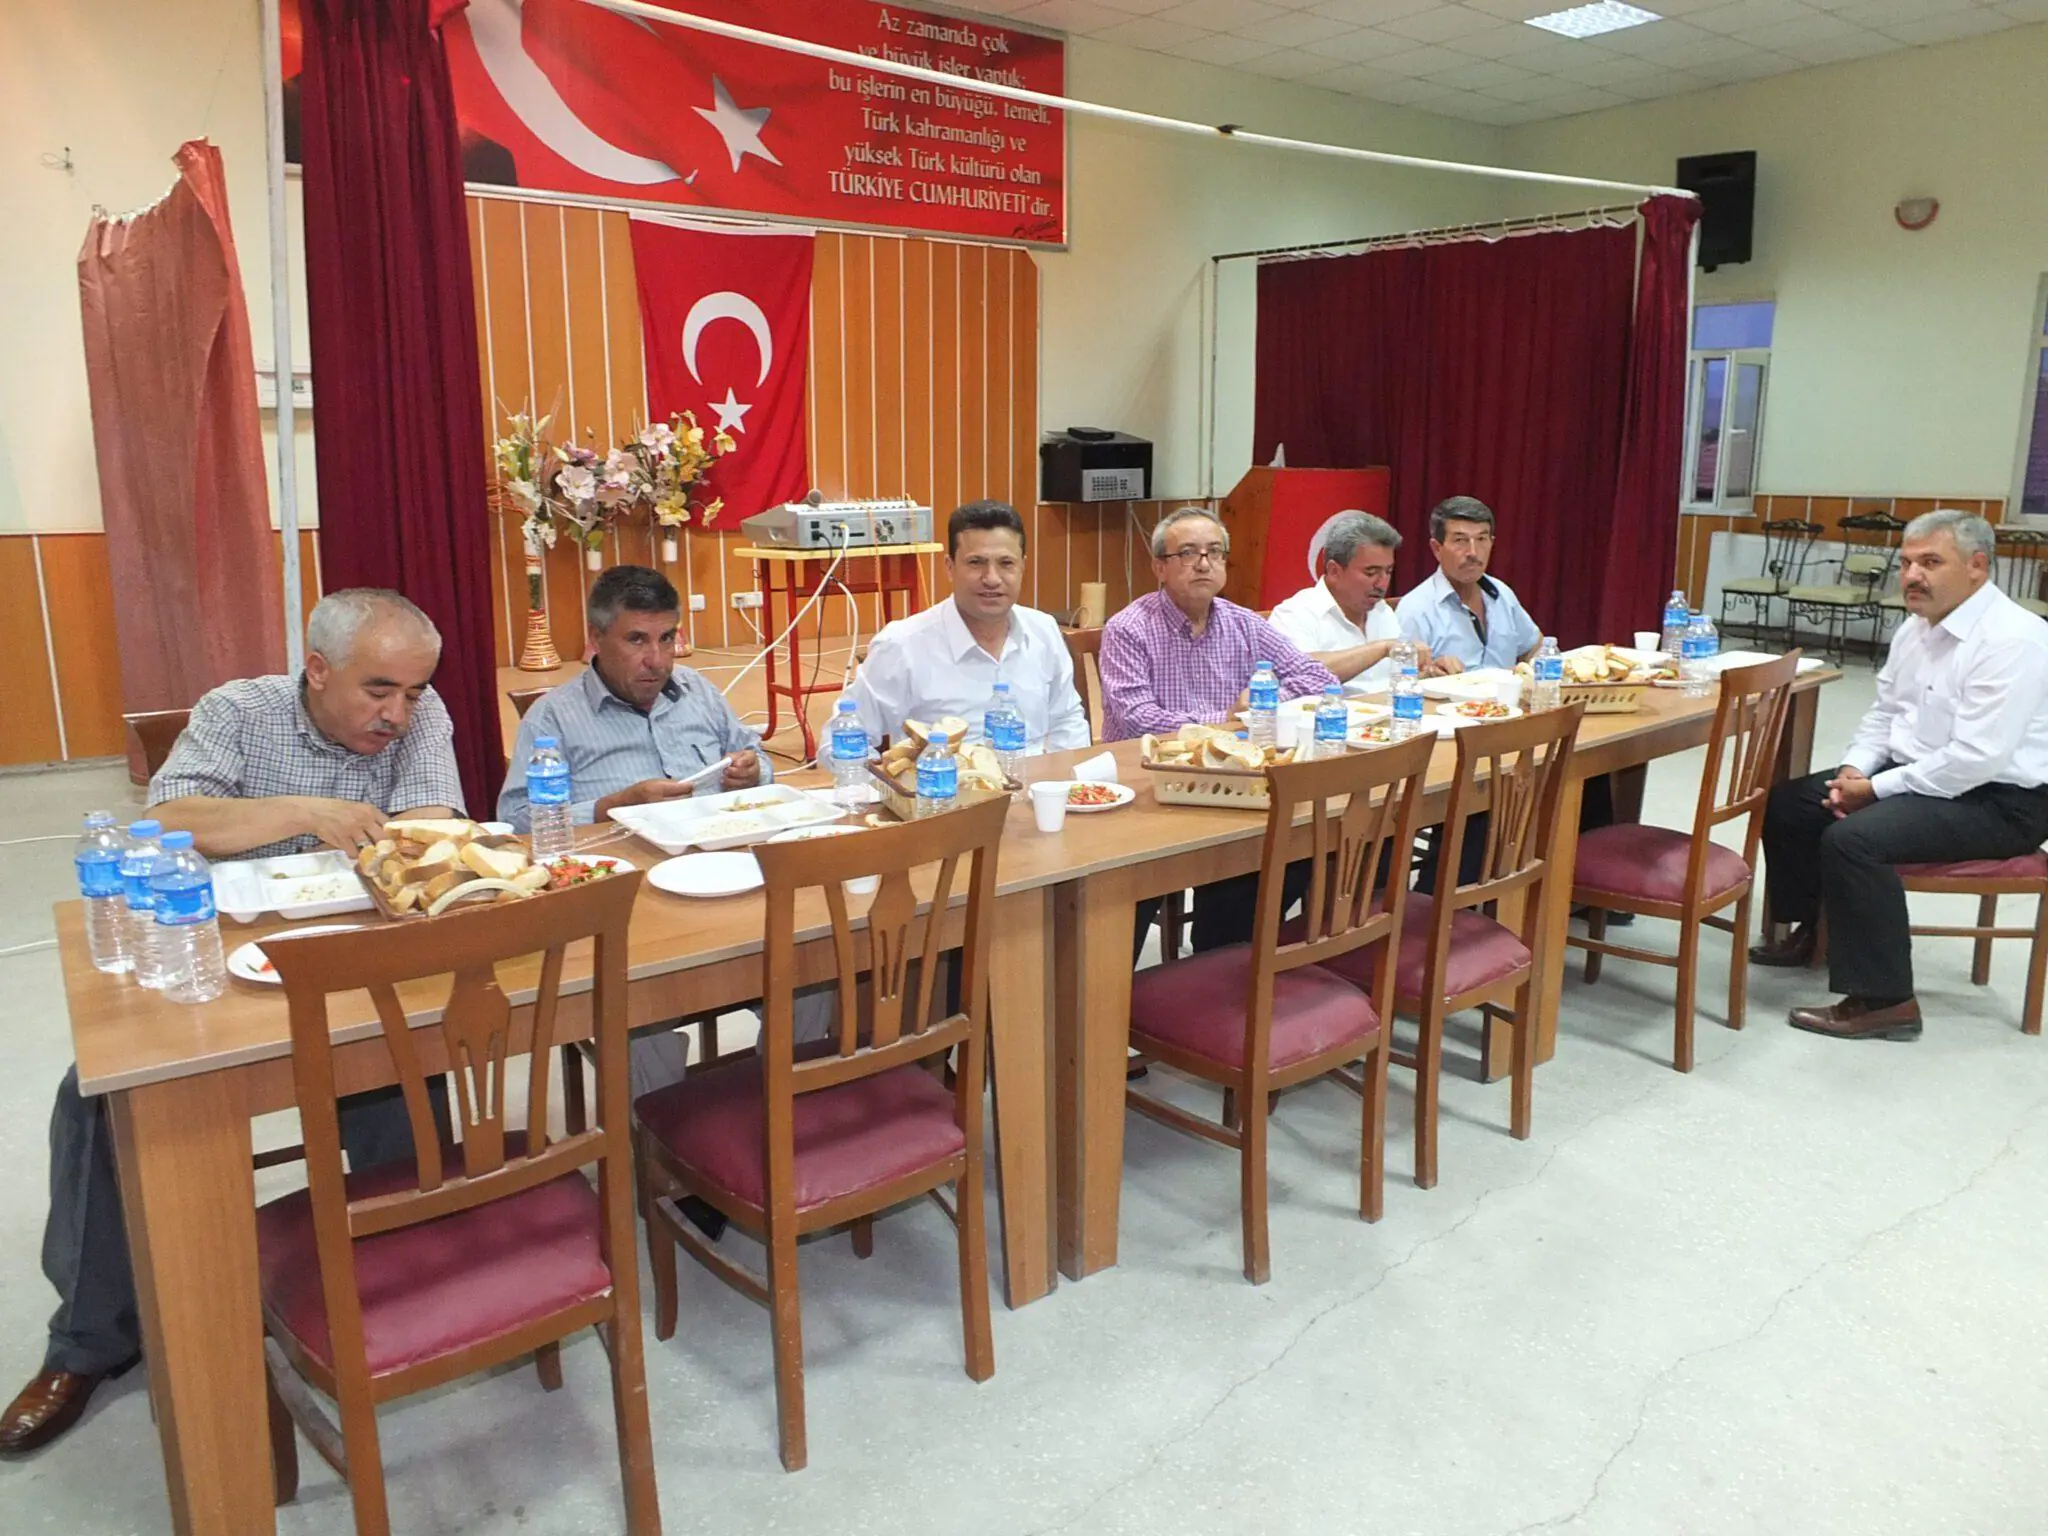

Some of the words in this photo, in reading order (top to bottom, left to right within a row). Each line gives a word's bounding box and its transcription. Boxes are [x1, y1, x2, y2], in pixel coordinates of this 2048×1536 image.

[878, 8, 900, 32] Az
[906, 20, 977, 47] zamanda
[982, 33, 1009, 56] çok
[829, 68, 852, 91] bu
[857, 73, 905, 102] işlerin
[911, 88, 931, 105] en
[861, 107, 900, 134] Türk
[905, 114, 1005, 153] kahramanlığı
[1009, 136, 1027, 152] ve
[827, 166, 904, 201] TÜRKİYE
[844, 141, 903, 168] yüksek
[908, 147, 945, 172] Türk
[950, 154, 1005, 181] kültürü
[1010, 163, 1041, 184] olan
